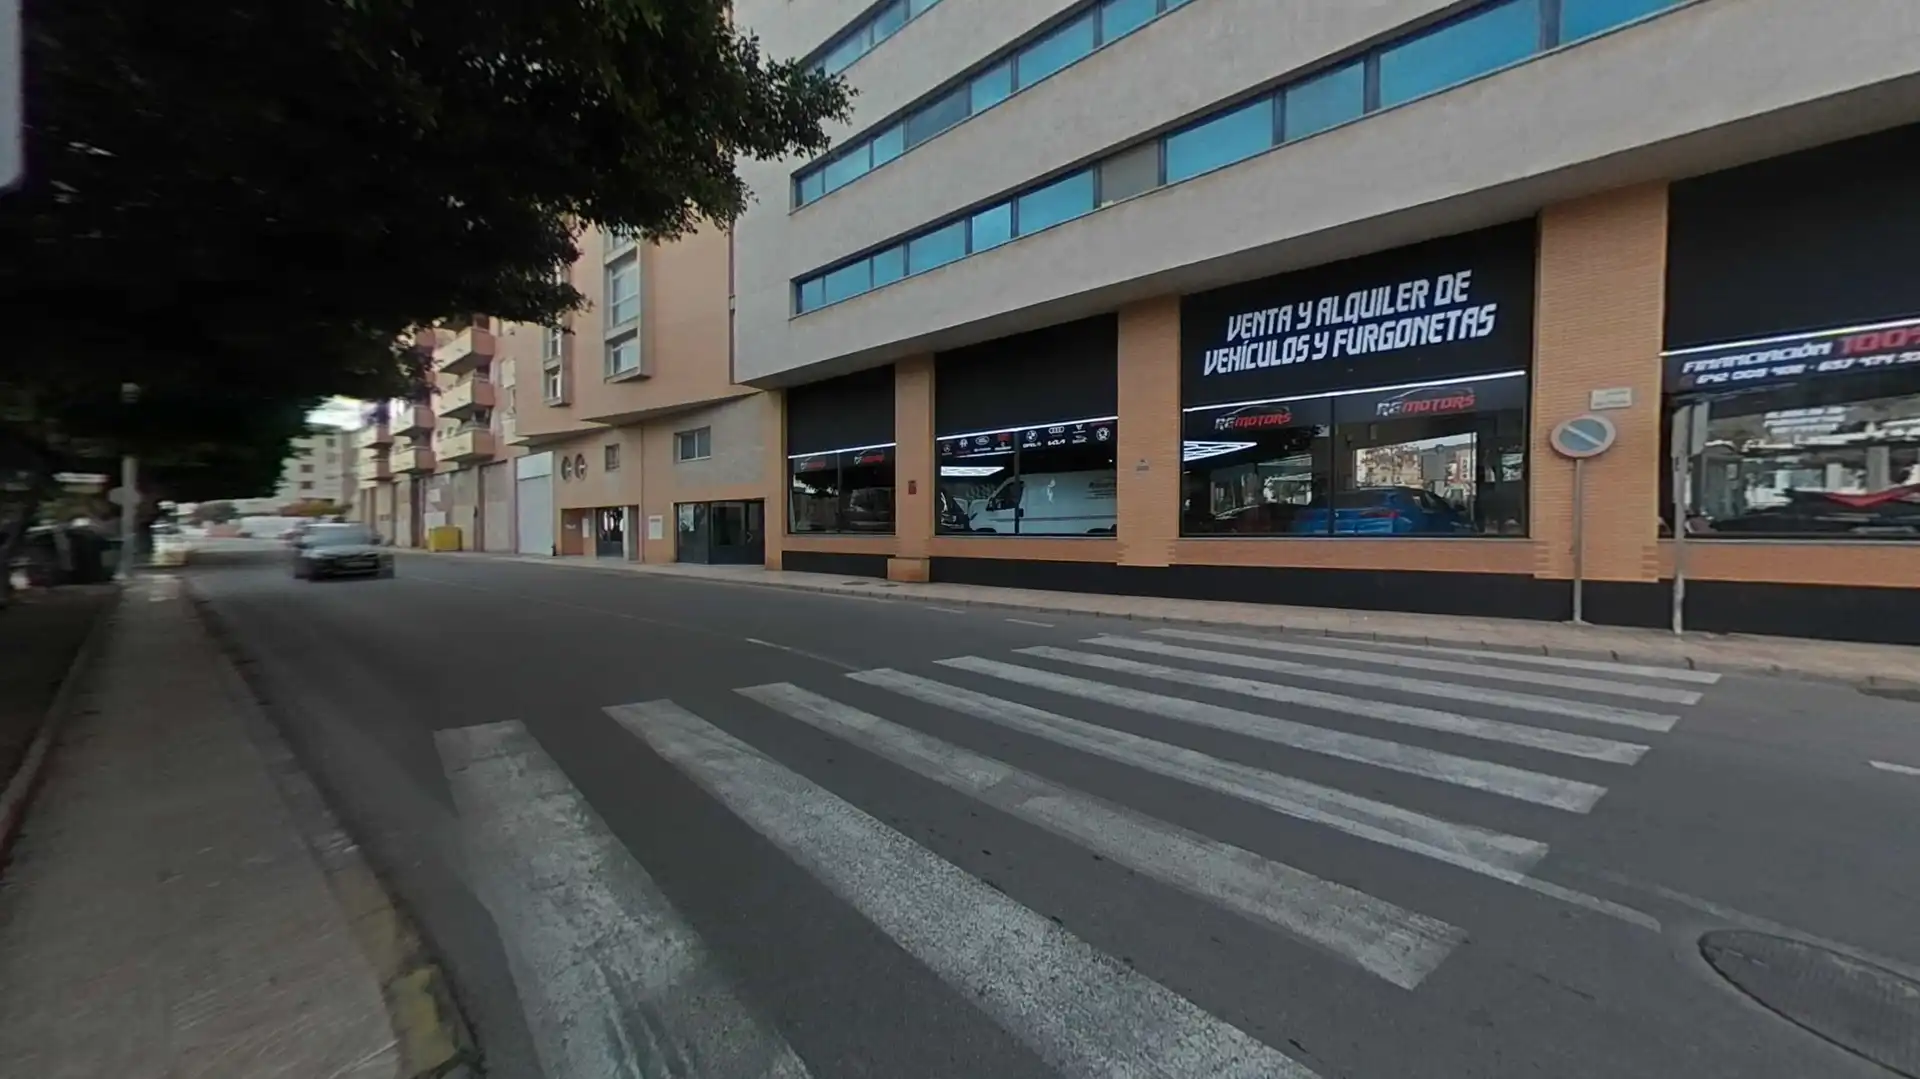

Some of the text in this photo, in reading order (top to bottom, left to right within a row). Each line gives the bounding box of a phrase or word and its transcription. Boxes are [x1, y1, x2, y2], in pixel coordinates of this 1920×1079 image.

[1203, 303, 1497, 376] VEHÍCULOS Y FURGONETAS
[1227, 269, 1472, 342] VENTA Y ALQUILER DE
